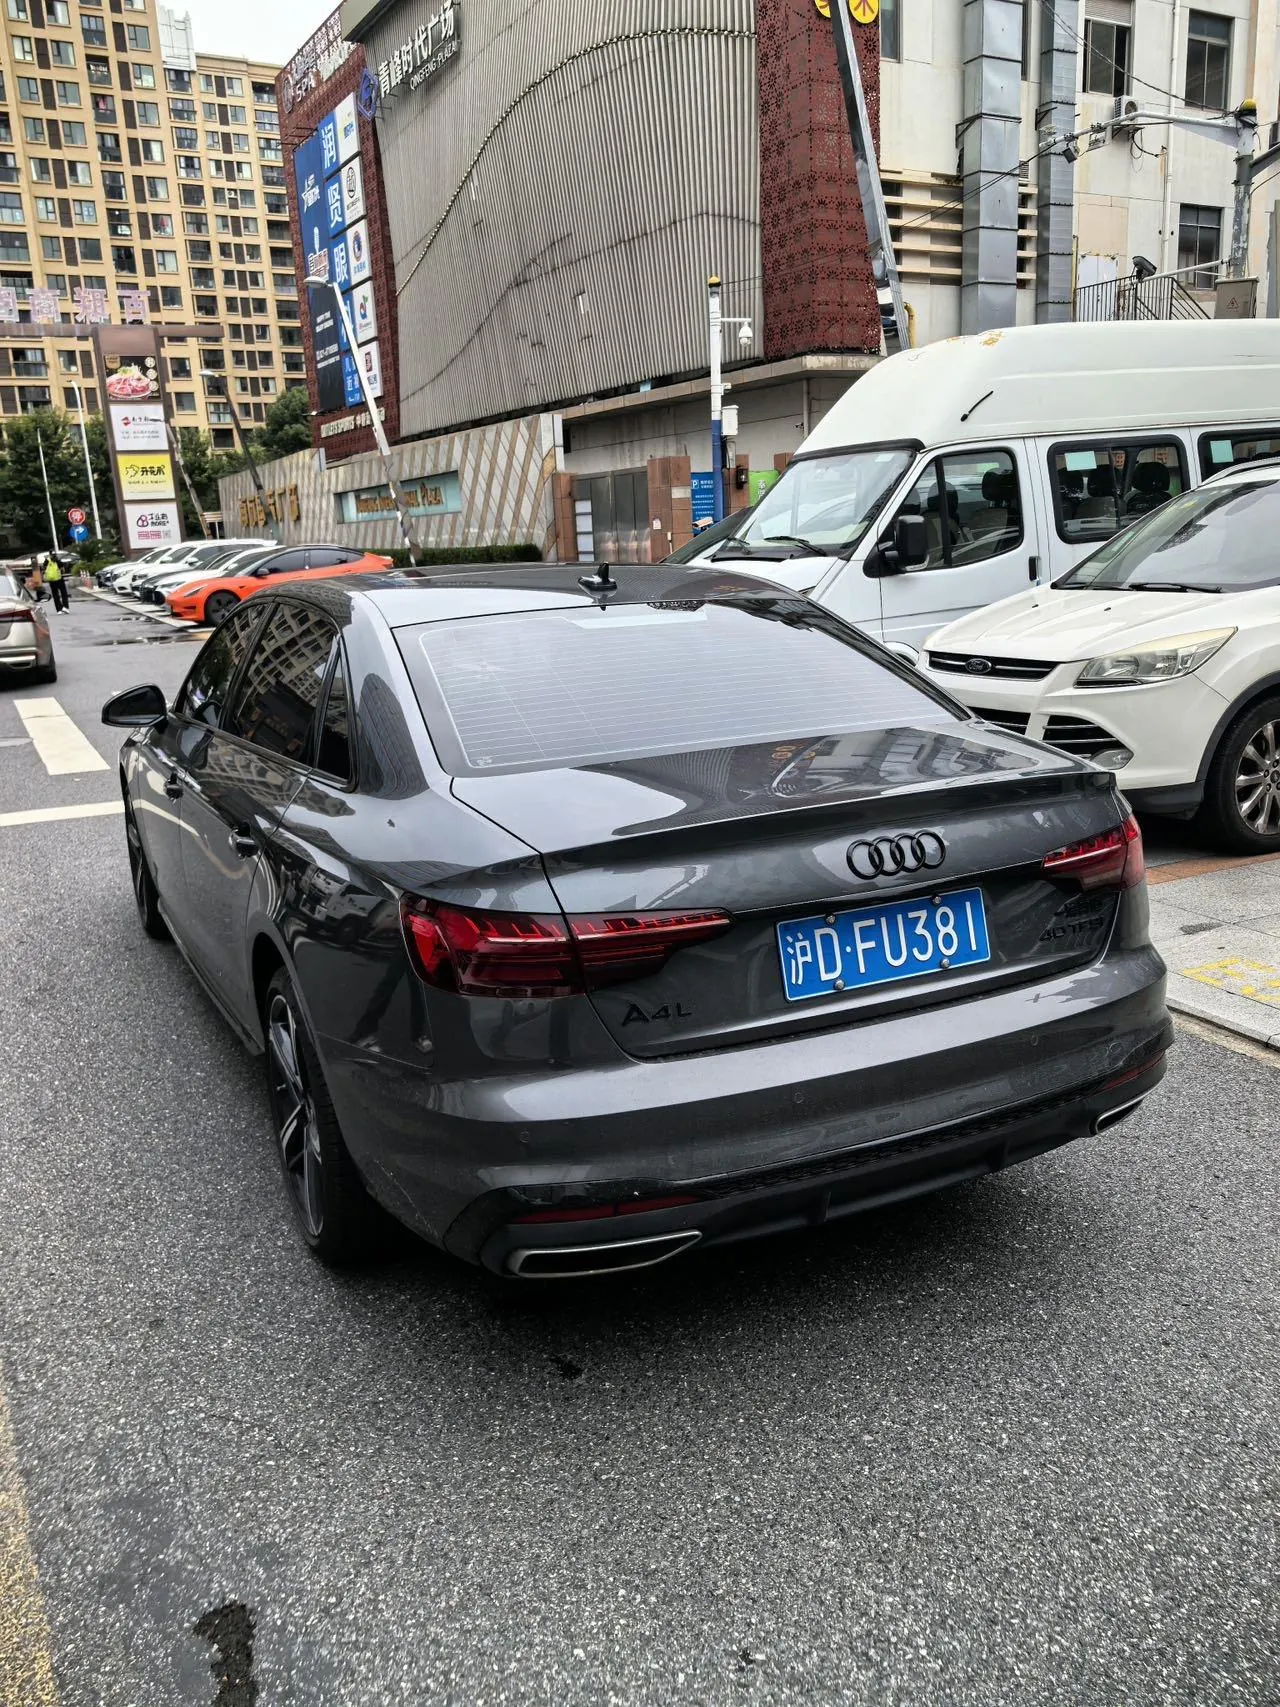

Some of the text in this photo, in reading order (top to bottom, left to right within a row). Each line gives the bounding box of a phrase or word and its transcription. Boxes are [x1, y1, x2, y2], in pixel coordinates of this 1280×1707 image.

[378, 0, 455, 98] 青峰时代广场
[409, 42, 458, 90] QINGFENG PLAZA
[786, 902, 977, 985] 沪D·FU381
[622, 1002, 692, 1027] A4L
